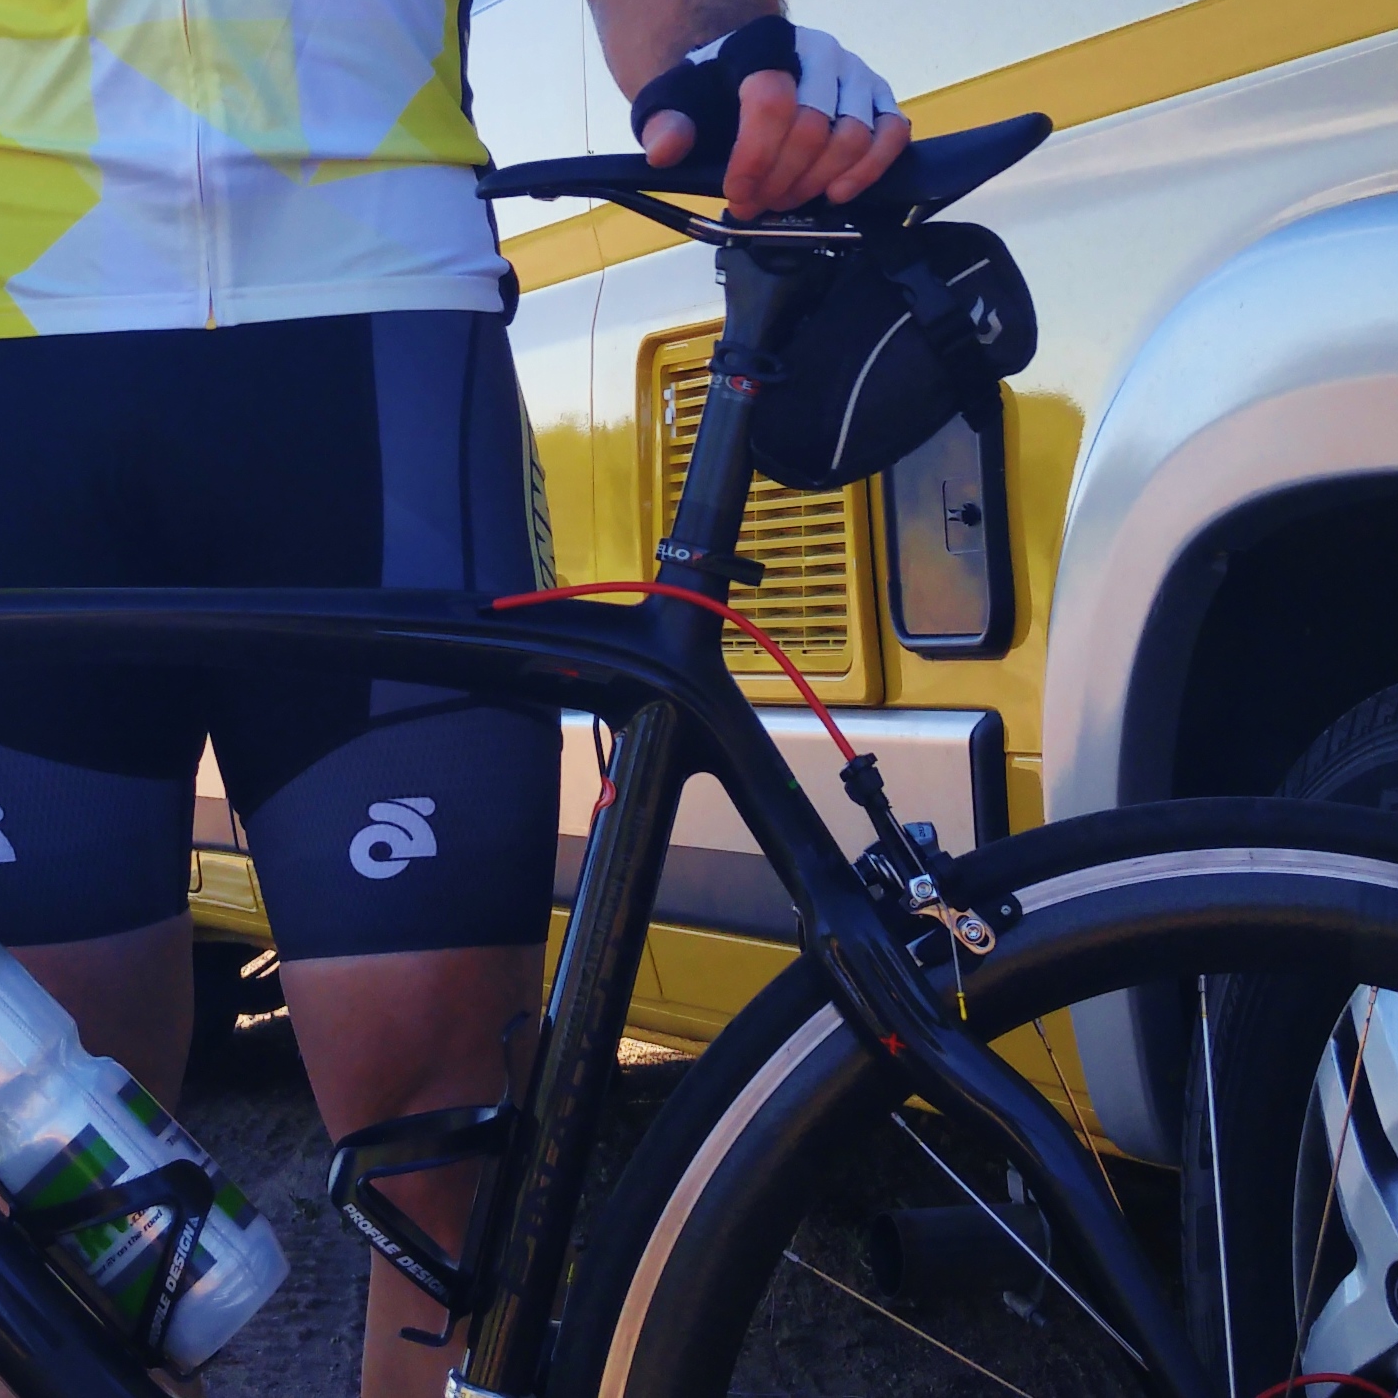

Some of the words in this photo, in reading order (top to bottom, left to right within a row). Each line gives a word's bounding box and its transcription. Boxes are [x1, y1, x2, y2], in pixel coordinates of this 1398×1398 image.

[657, 543, 691, 560] ELLO
[143, 1208, 163, 1232] road
[342, 1202, 402, 1255] PROFILE
[165, 1223, 196, 1294] DESIGN
